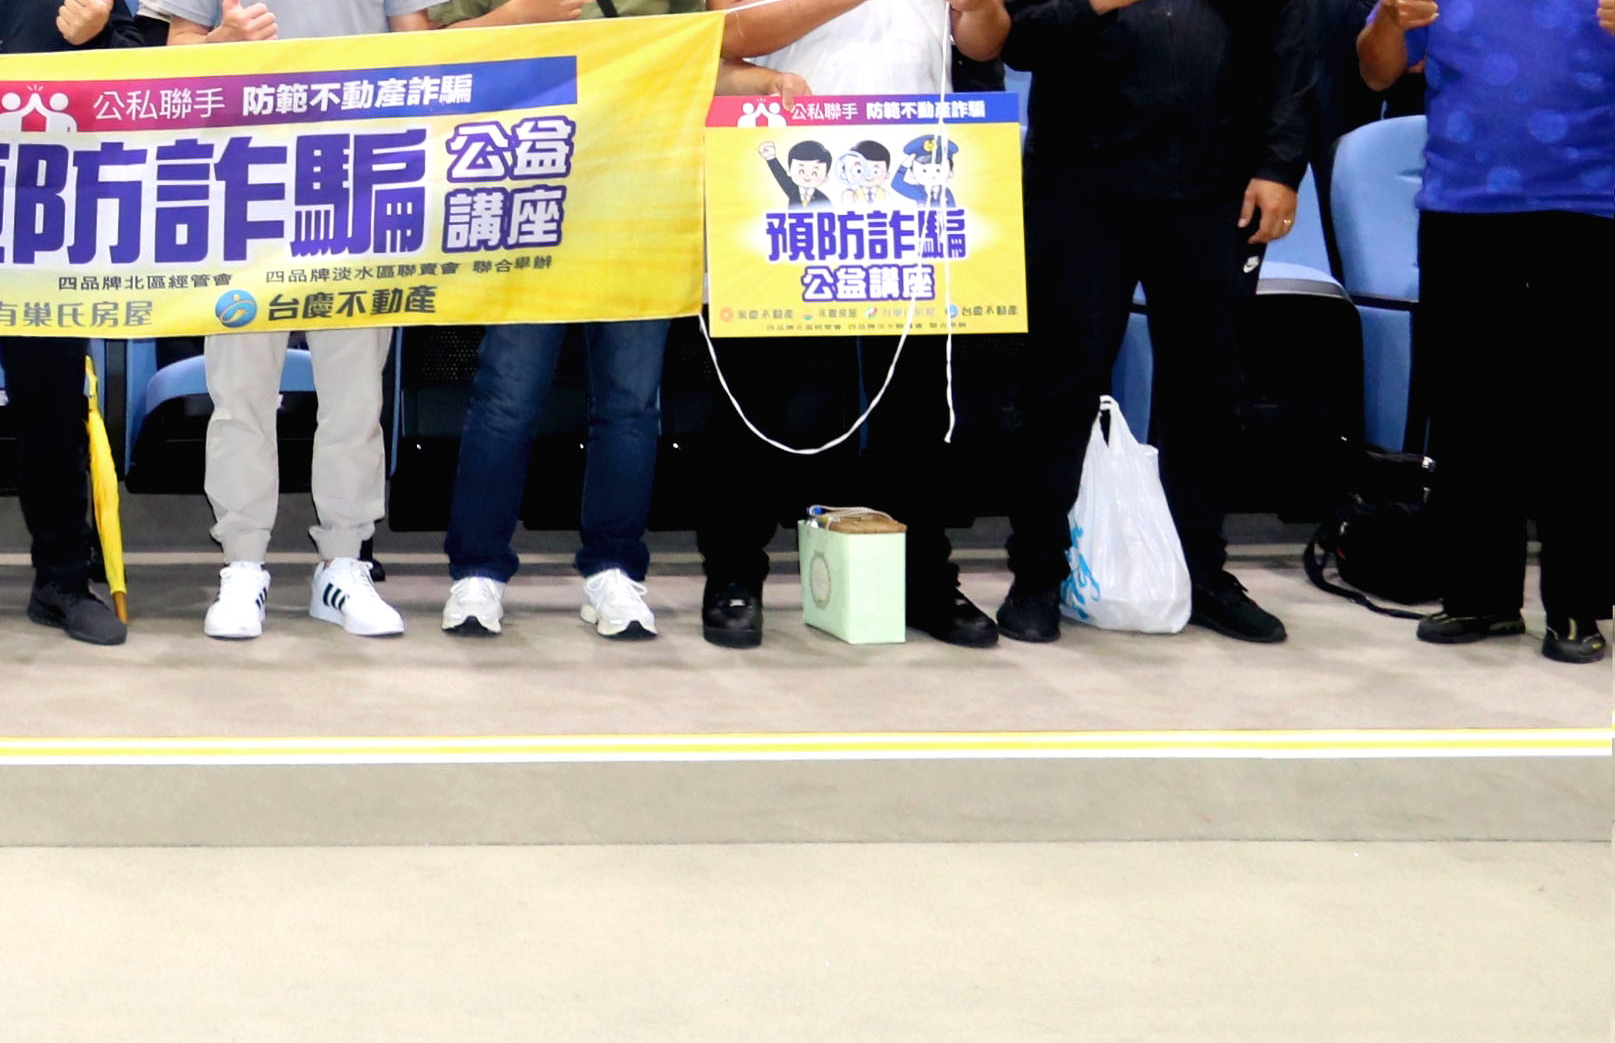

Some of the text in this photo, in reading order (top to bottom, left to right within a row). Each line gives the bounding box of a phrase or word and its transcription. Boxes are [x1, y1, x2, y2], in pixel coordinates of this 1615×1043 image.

[94, 74, 473, 123] 公私聯手 防範不動產詐騙
[790, 102, 859, 121] 公私聯手
[446, 116, 575, 183] 公益
[442, 185, 565, 254] 講座
[766, 209, 966, 262] 預防詐騙
[472, 254, 553, 274] 聯合舉辦
[800, 263, 936, 302] 公益講座
[267, 284, 437, 321] 台慶不動產
